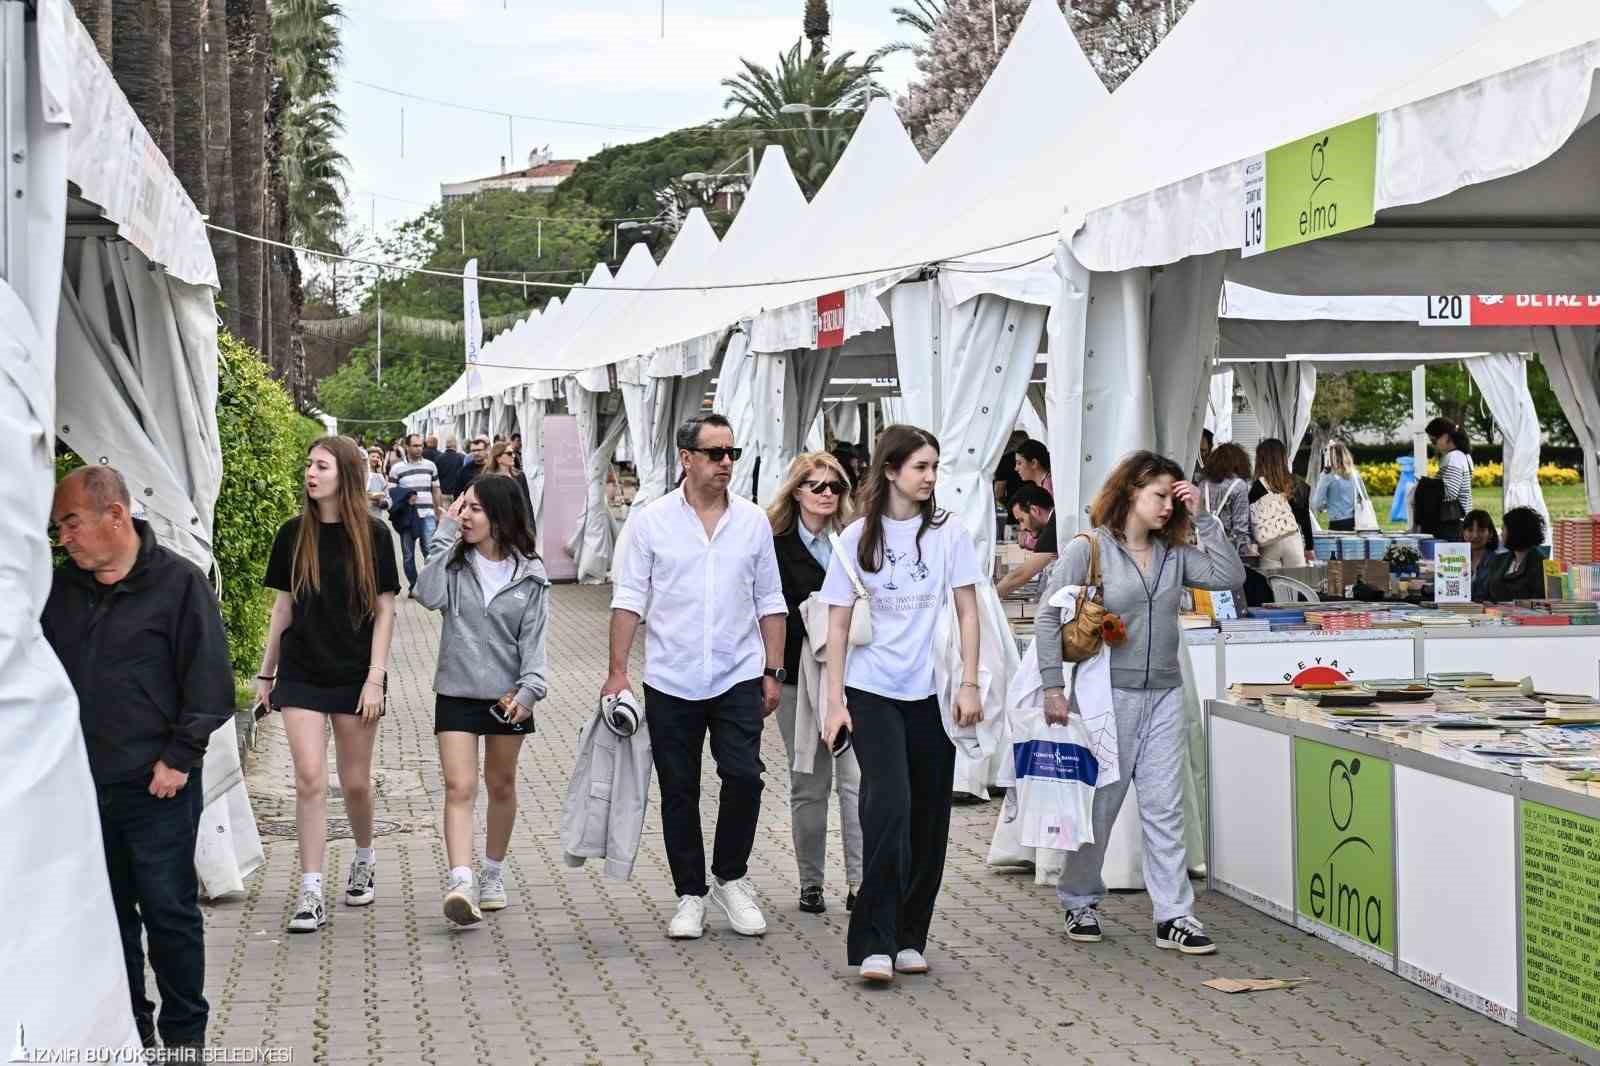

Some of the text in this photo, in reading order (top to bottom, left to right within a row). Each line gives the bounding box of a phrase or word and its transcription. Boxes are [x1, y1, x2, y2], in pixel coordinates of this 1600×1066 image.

[1245, 207, 1262, 247] L19
[1299, 200, 1337, 236] elma
[1427, 296, 1462, 319] L20
[1283, 657, 1355, 682] BEYAZ
[1310, 862, 1382, 946] elma
